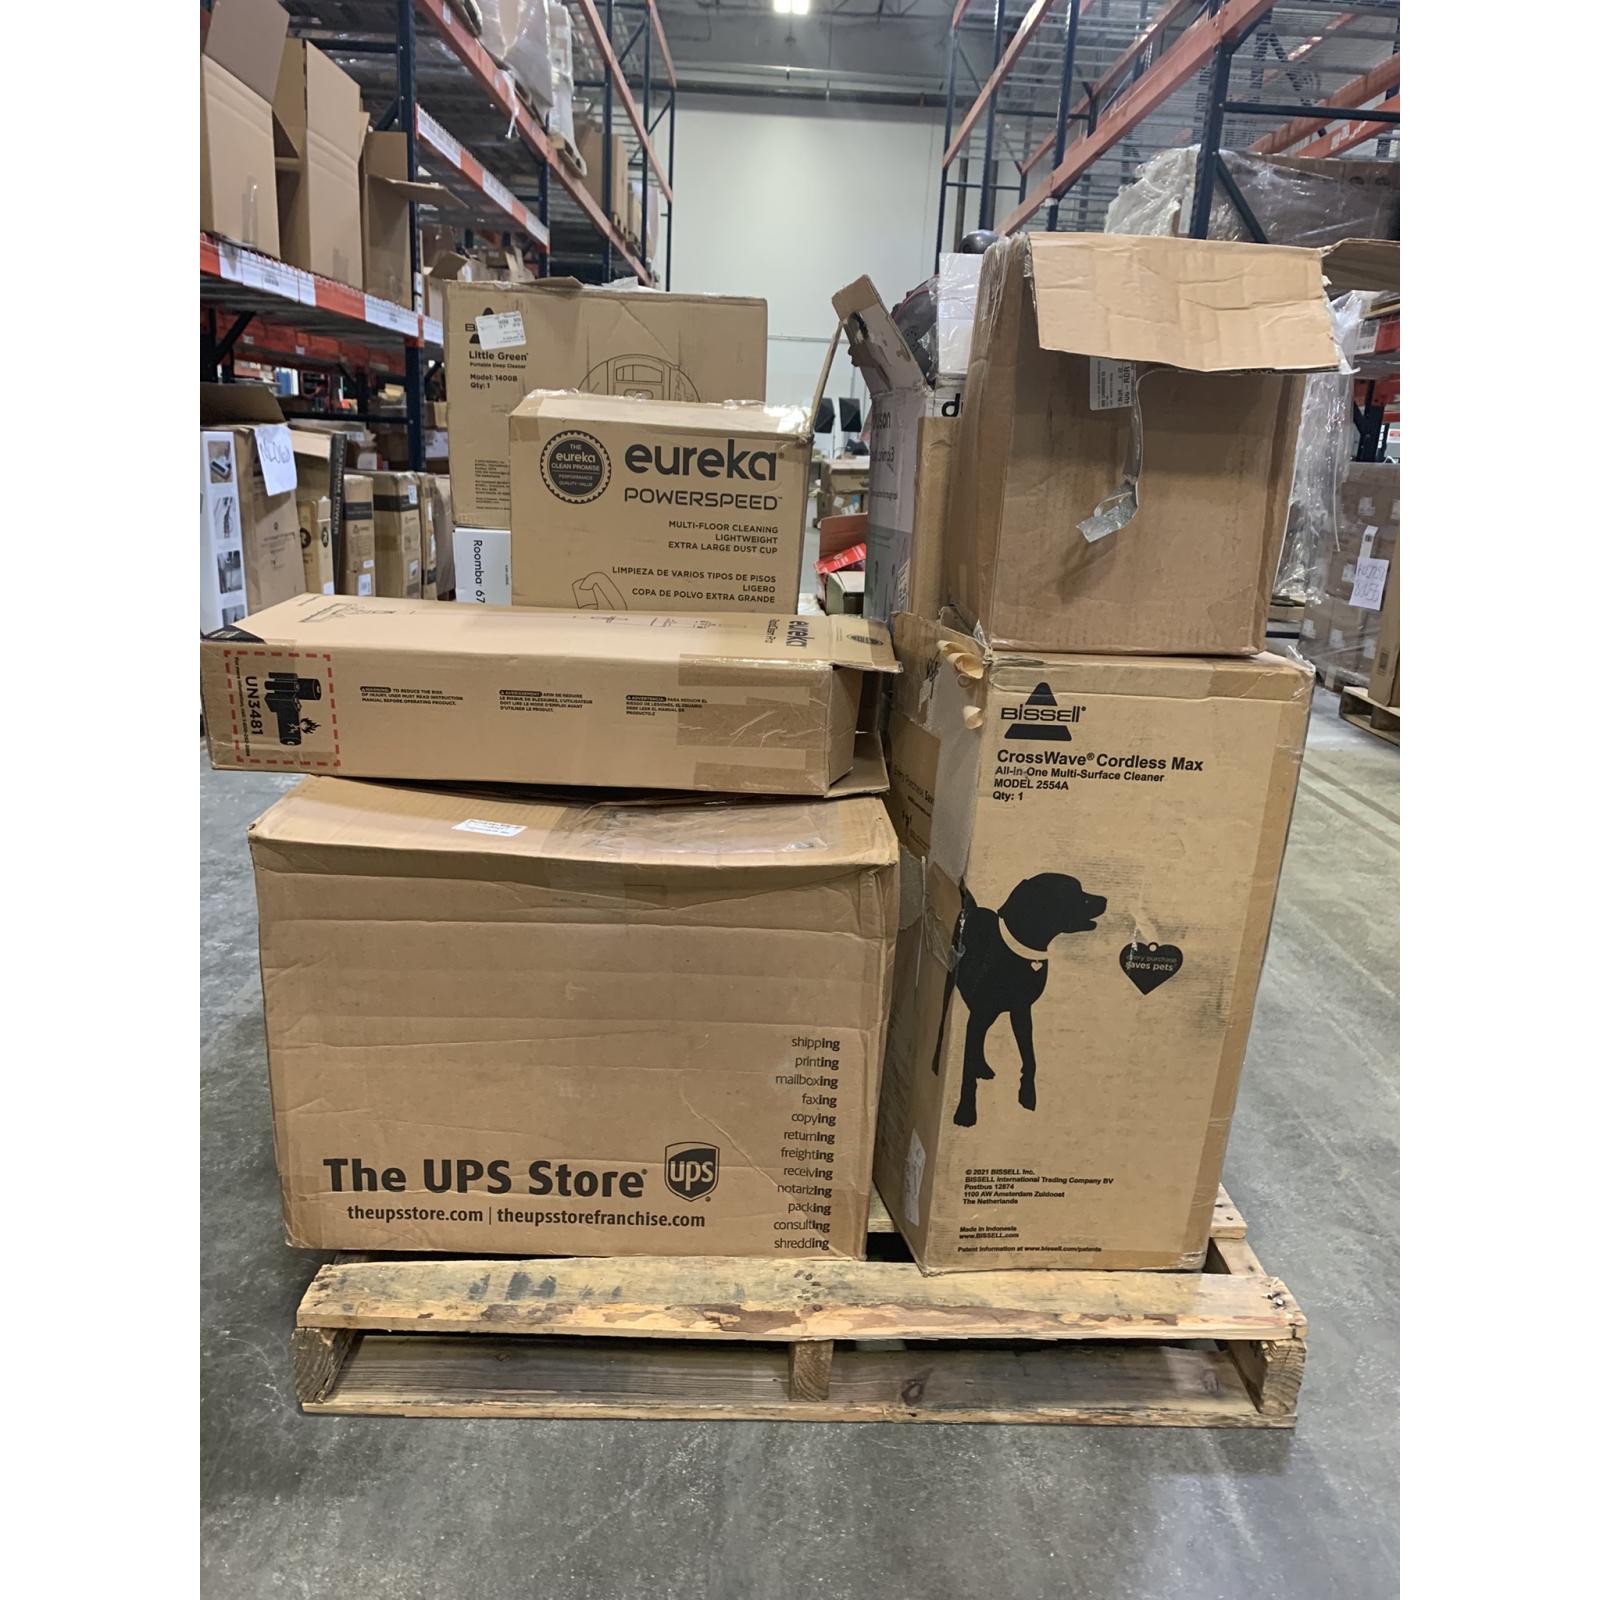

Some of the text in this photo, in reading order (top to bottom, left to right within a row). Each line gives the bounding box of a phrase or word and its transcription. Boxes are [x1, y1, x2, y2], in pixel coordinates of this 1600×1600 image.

[469, 350, 527, 361] Little Green
[470, 373, 493, 381] Model:
[556, 451, 596, 463] eureka
[625, 438, 777, 480] eureka
[624, 488, 778, 510] POWERSPEED
[668, 520, 778, 534] MULTI-FLOOR CLEANING
[715, 534, 778, 544] LIGHTWEIGHT
[668, 541, 778, 554] EXTRA LARGE DUST CUP
[473, 540, 484, 585] Roomba
[612, 566, 776, 583] LIMPIEZA DE VARIOS TIPOS DE PISOS
[742, 584, 776, 593] LIGERO
[632, 588, 775, 604] COPA DE POLVO EXTRA GRANDE
[786, 620, 815, 646] eureka
[245, 676, 264, 736] UN3481
[1097, 754, 1166, 770] Cordless
[1172, 756, 1204, 772] Max
[995, 766, 1164, 782] All-in-One Multi-Surface Cleaner
[994, 778, 1070, 790] MODEL 2554A
[992, 790, 1024, 802] Qty: 1
[1152, 963, 1174, 971] pets
[792, 1036, 840, 1052] shipping
[795, 1056, 840, 1070] printing
[776, 1074, 838, 1090] mailboxing
[802, 1094, 838, 1108] faxing
[792, 1113, 836, 1126] copying
[784, 1130, 836, 1145] returning
[781, 1147, 834, 1163] freighting
[323, 1158, 644, 1198] The UPS Store
[670, 1160, 714, 1191] ups
[784, 1167, 834, 1180] receiving
[1069, 1177, 1101, 1185] Company
[777, 1184, 832, 1198] notarizing
[788, 1202, 832, 1216] packing
[347, 1205, 706, 1228] theupsstore.com theupsstorefranchise.com
[774, 1220, 830, 1233] consulting
[774, 1238, 830, 1251] shredding
